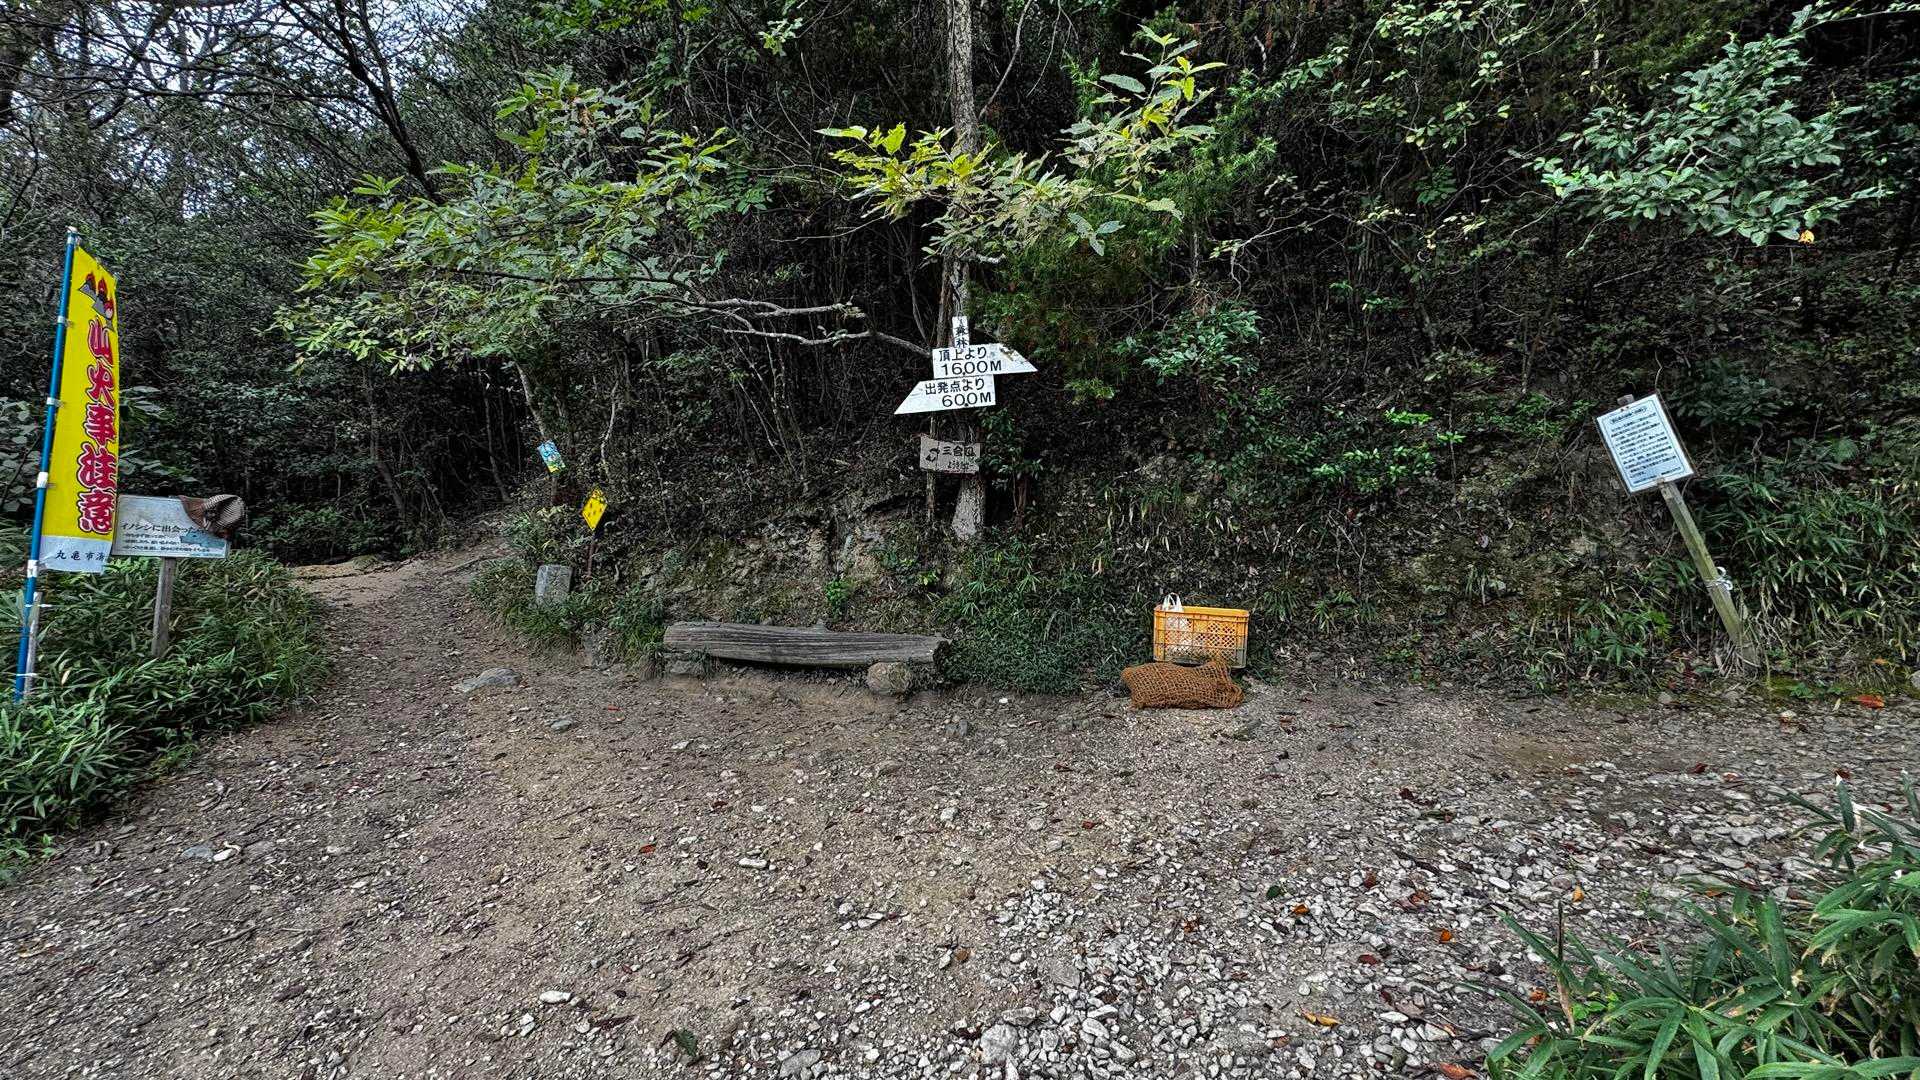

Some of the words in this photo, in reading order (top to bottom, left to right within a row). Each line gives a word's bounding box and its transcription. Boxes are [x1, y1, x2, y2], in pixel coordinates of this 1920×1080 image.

[939, 347, 987, 362] 頂上より
[941, 360, 1002, 376] 1600M
[925, 378, 985, 396] 出発点より
[942, 392, 992, 408] 600M
[77, 317, 117, 534] 山火事注意
